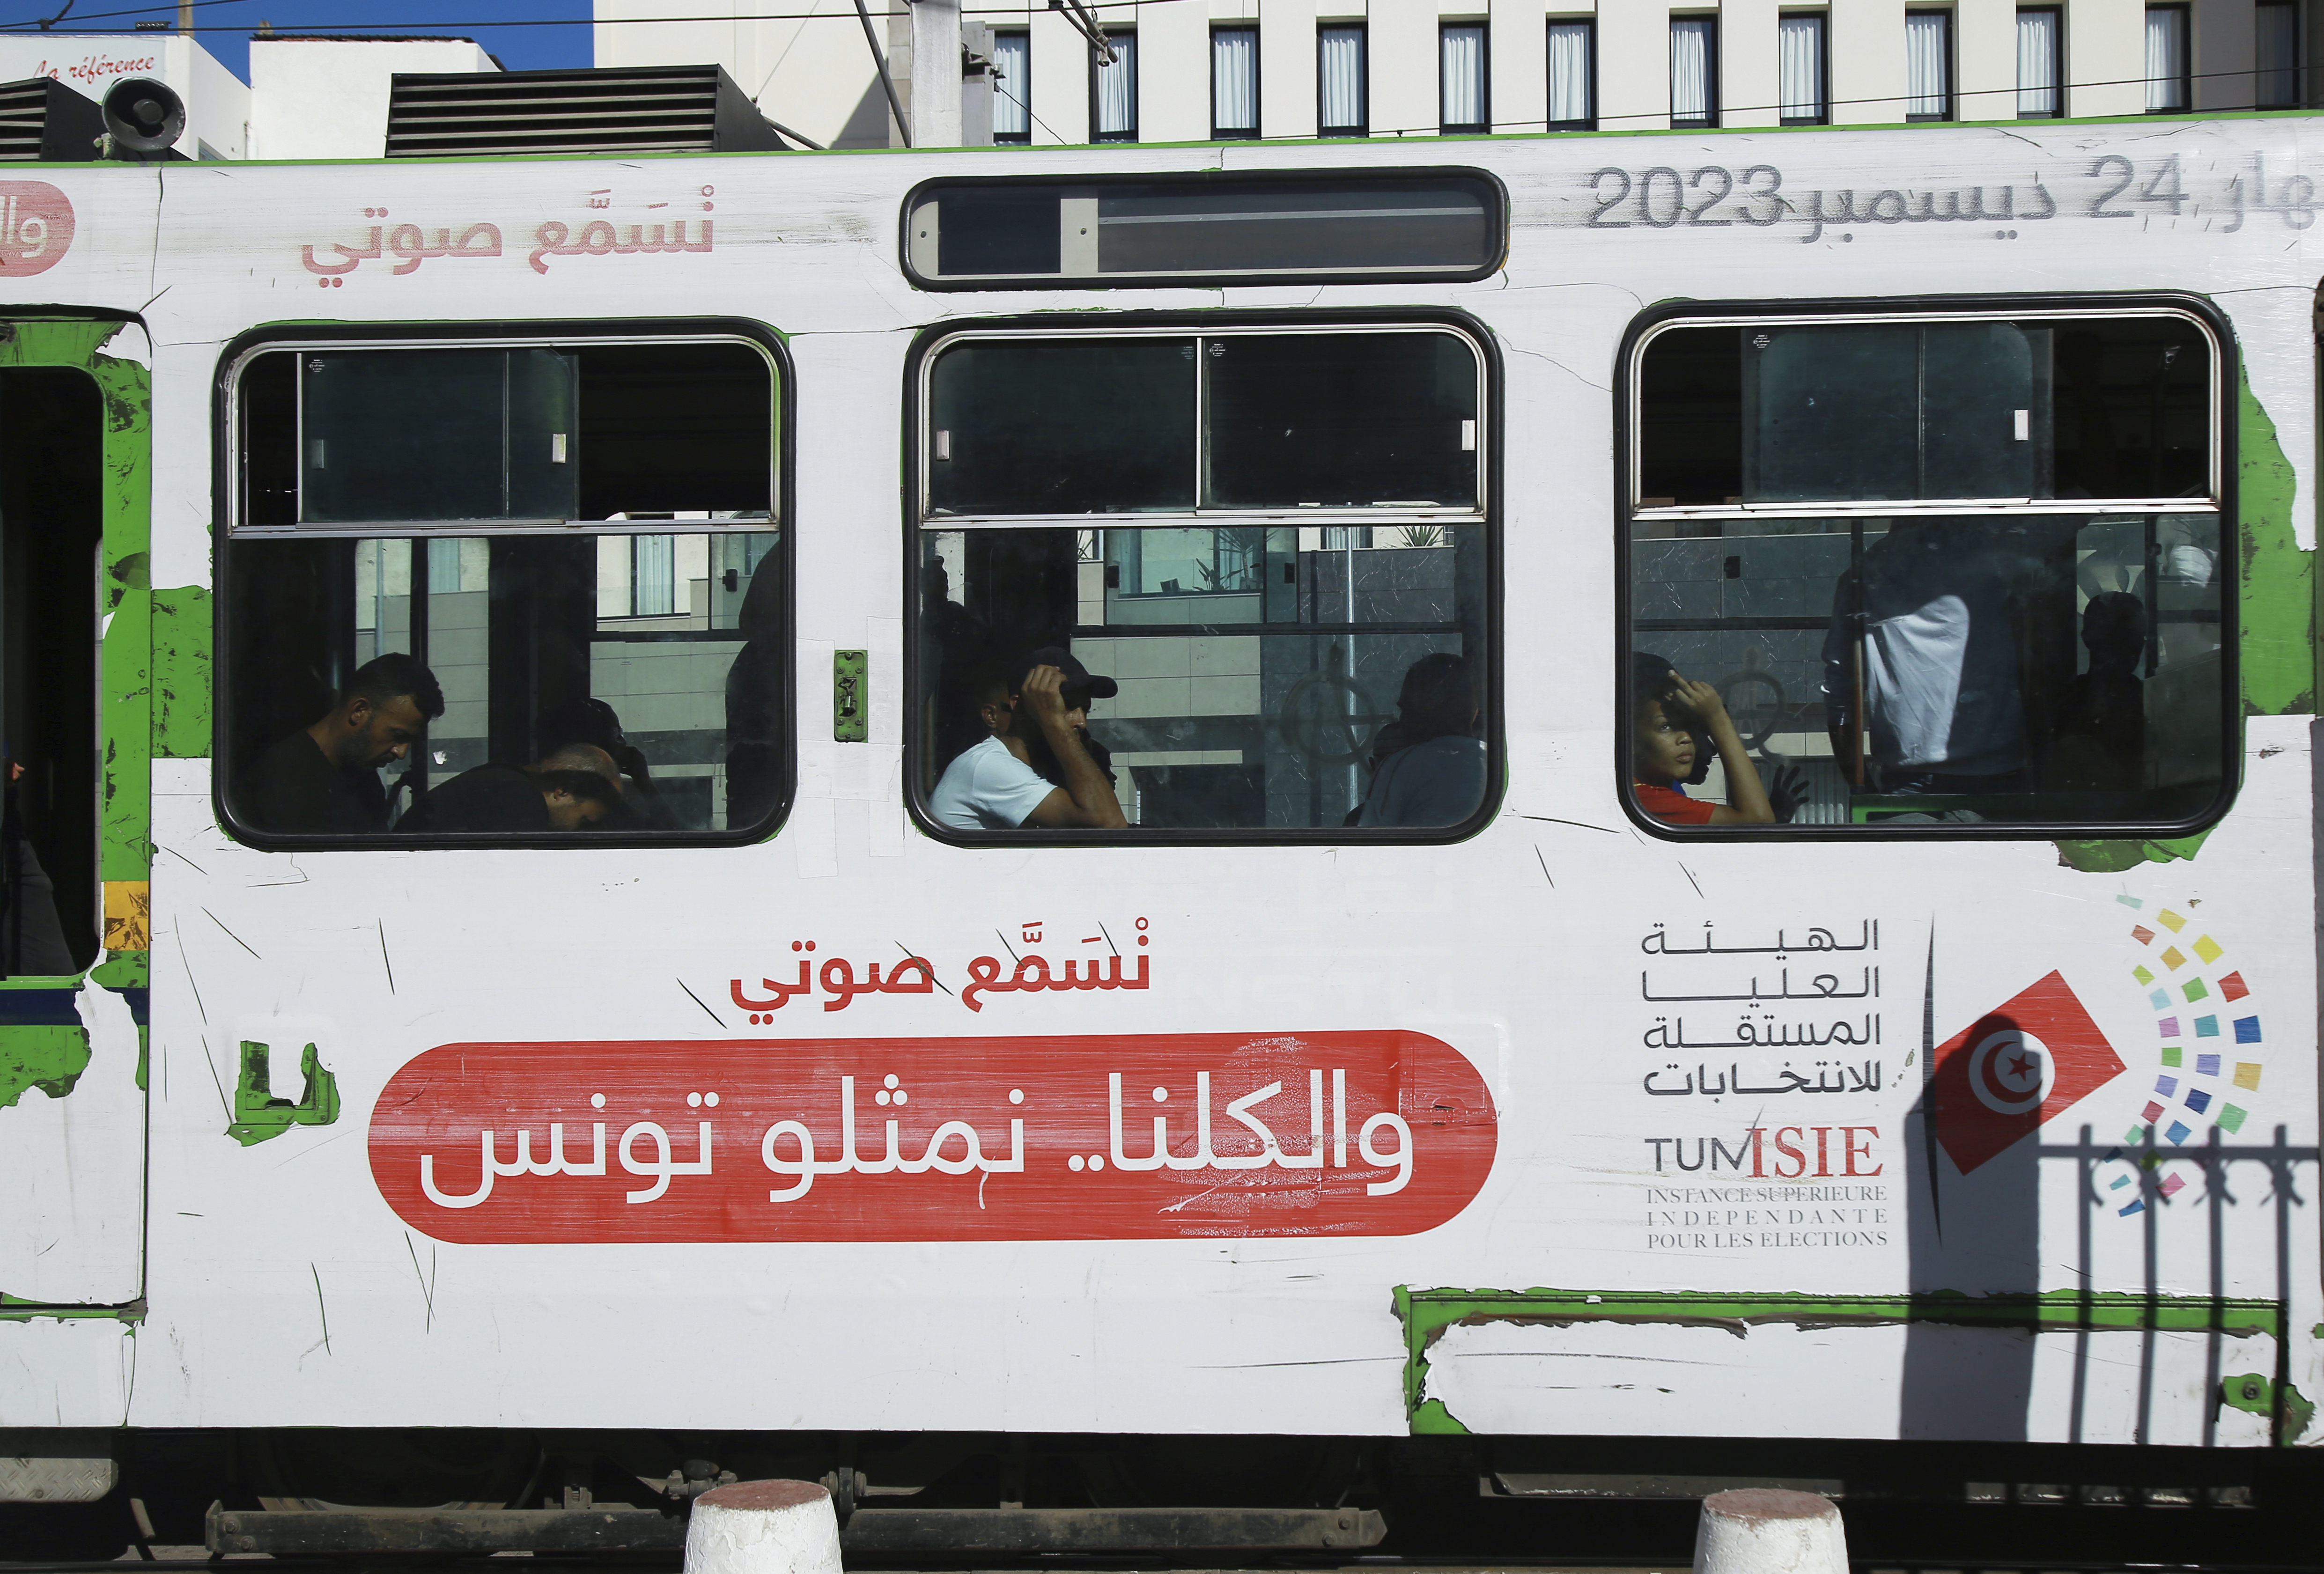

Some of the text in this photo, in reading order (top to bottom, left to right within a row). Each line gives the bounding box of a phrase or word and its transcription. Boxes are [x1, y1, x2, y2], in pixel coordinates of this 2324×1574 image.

[69, 54, 155, 84] référence
[2088, 153, 2190, 218] 24
[2224, 149, 2324, 234] هار
[302, 206, 502, 288] صوتي
[1642, 918, 1879, 961] الهيئة
[730, 940, 935, 1025] صوتي
[1642, 965, 1879, 1008] العليا
[1643, 1013, 1880, 1049] المستقلة
[1643, 1060, 1881, 1103] للانتخابات
[420, 1091, 720, 1209] تونس
[761, 1073, 1025, 1203] نمثلو
[1647, 1185, 1887, 1204] INSTANCE SUPERIEURE
[1647, 1208, 1887, 1227] INDEPENDANTE
[1648, 1231, 1888, 1249] POUR LES ELECTIONS
